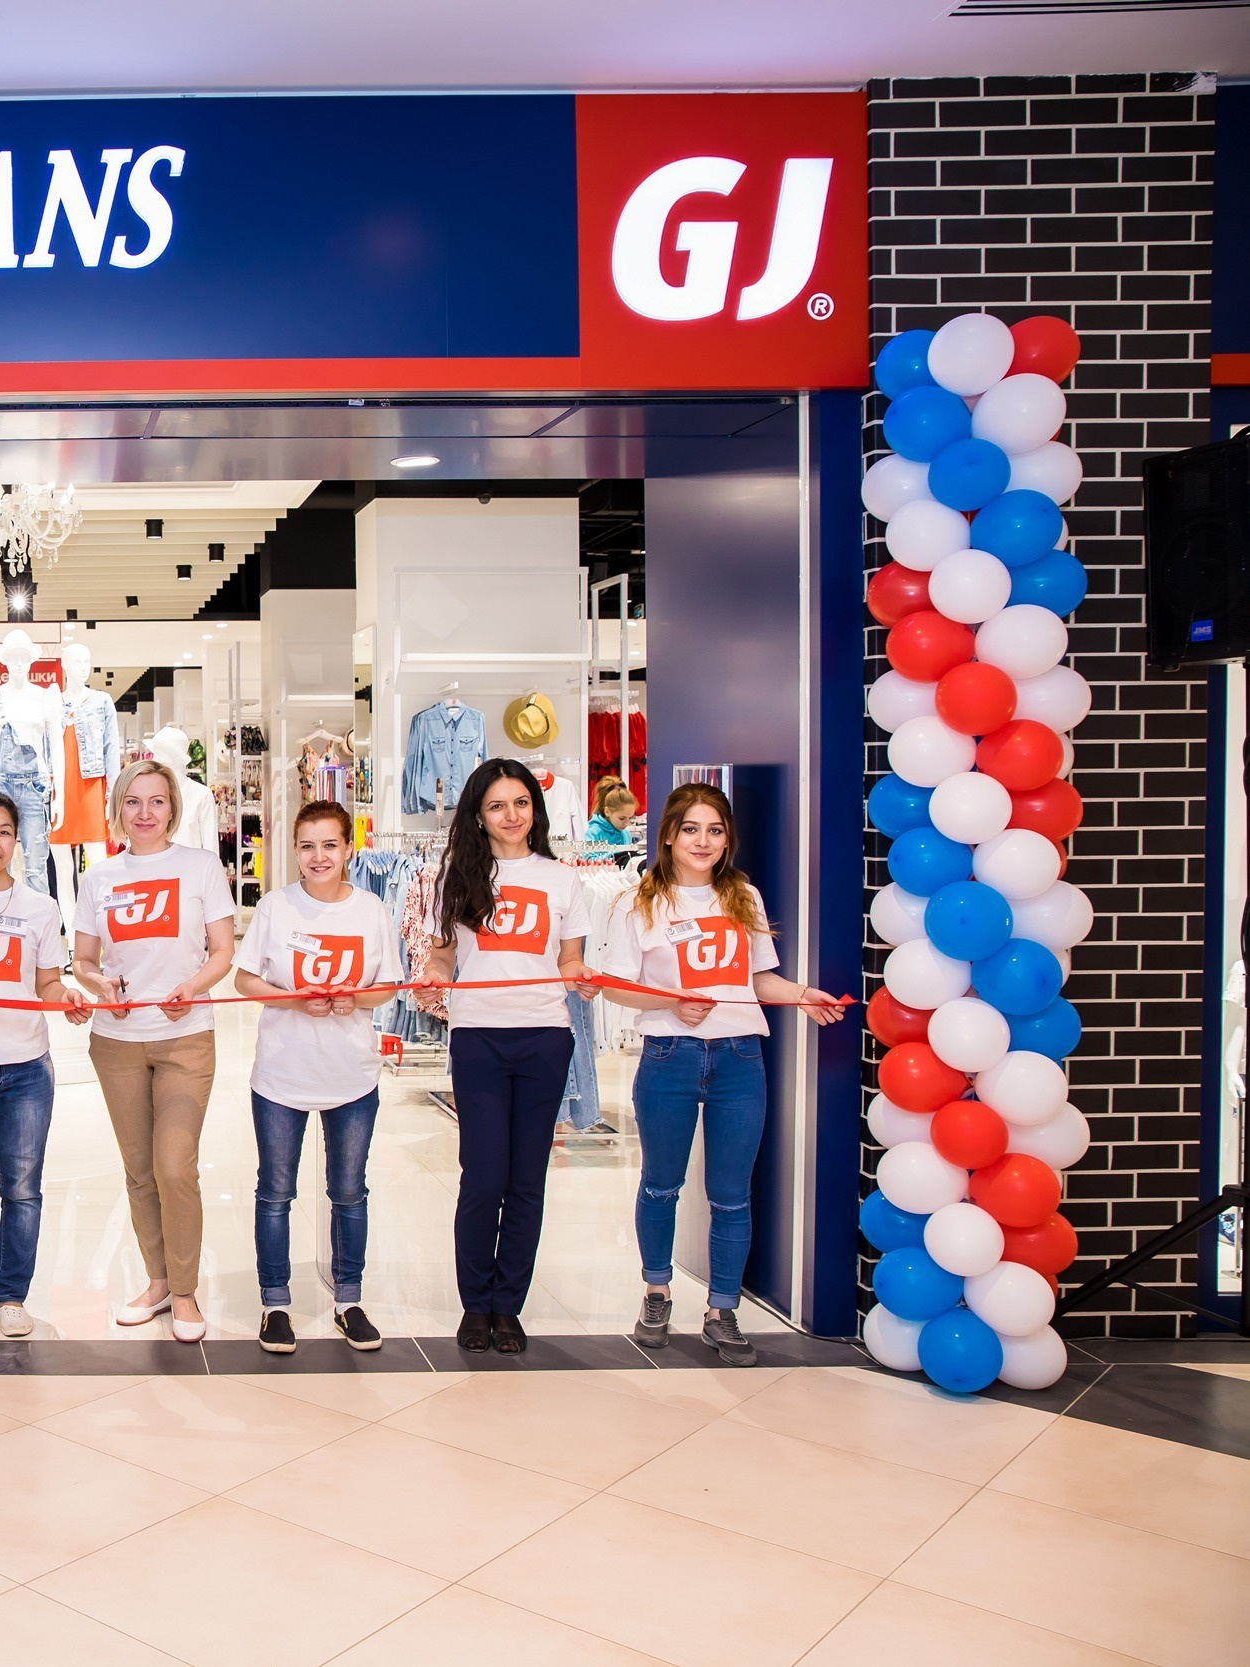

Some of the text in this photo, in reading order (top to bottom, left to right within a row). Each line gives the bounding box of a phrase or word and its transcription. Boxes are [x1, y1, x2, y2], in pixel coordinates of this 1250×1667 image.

[114, 889, 170, 926] GJ
[482, 900, 538, 935] GJ
[301, 949, 354, 985] GJ
[686, 929, 738, 971] GJ
